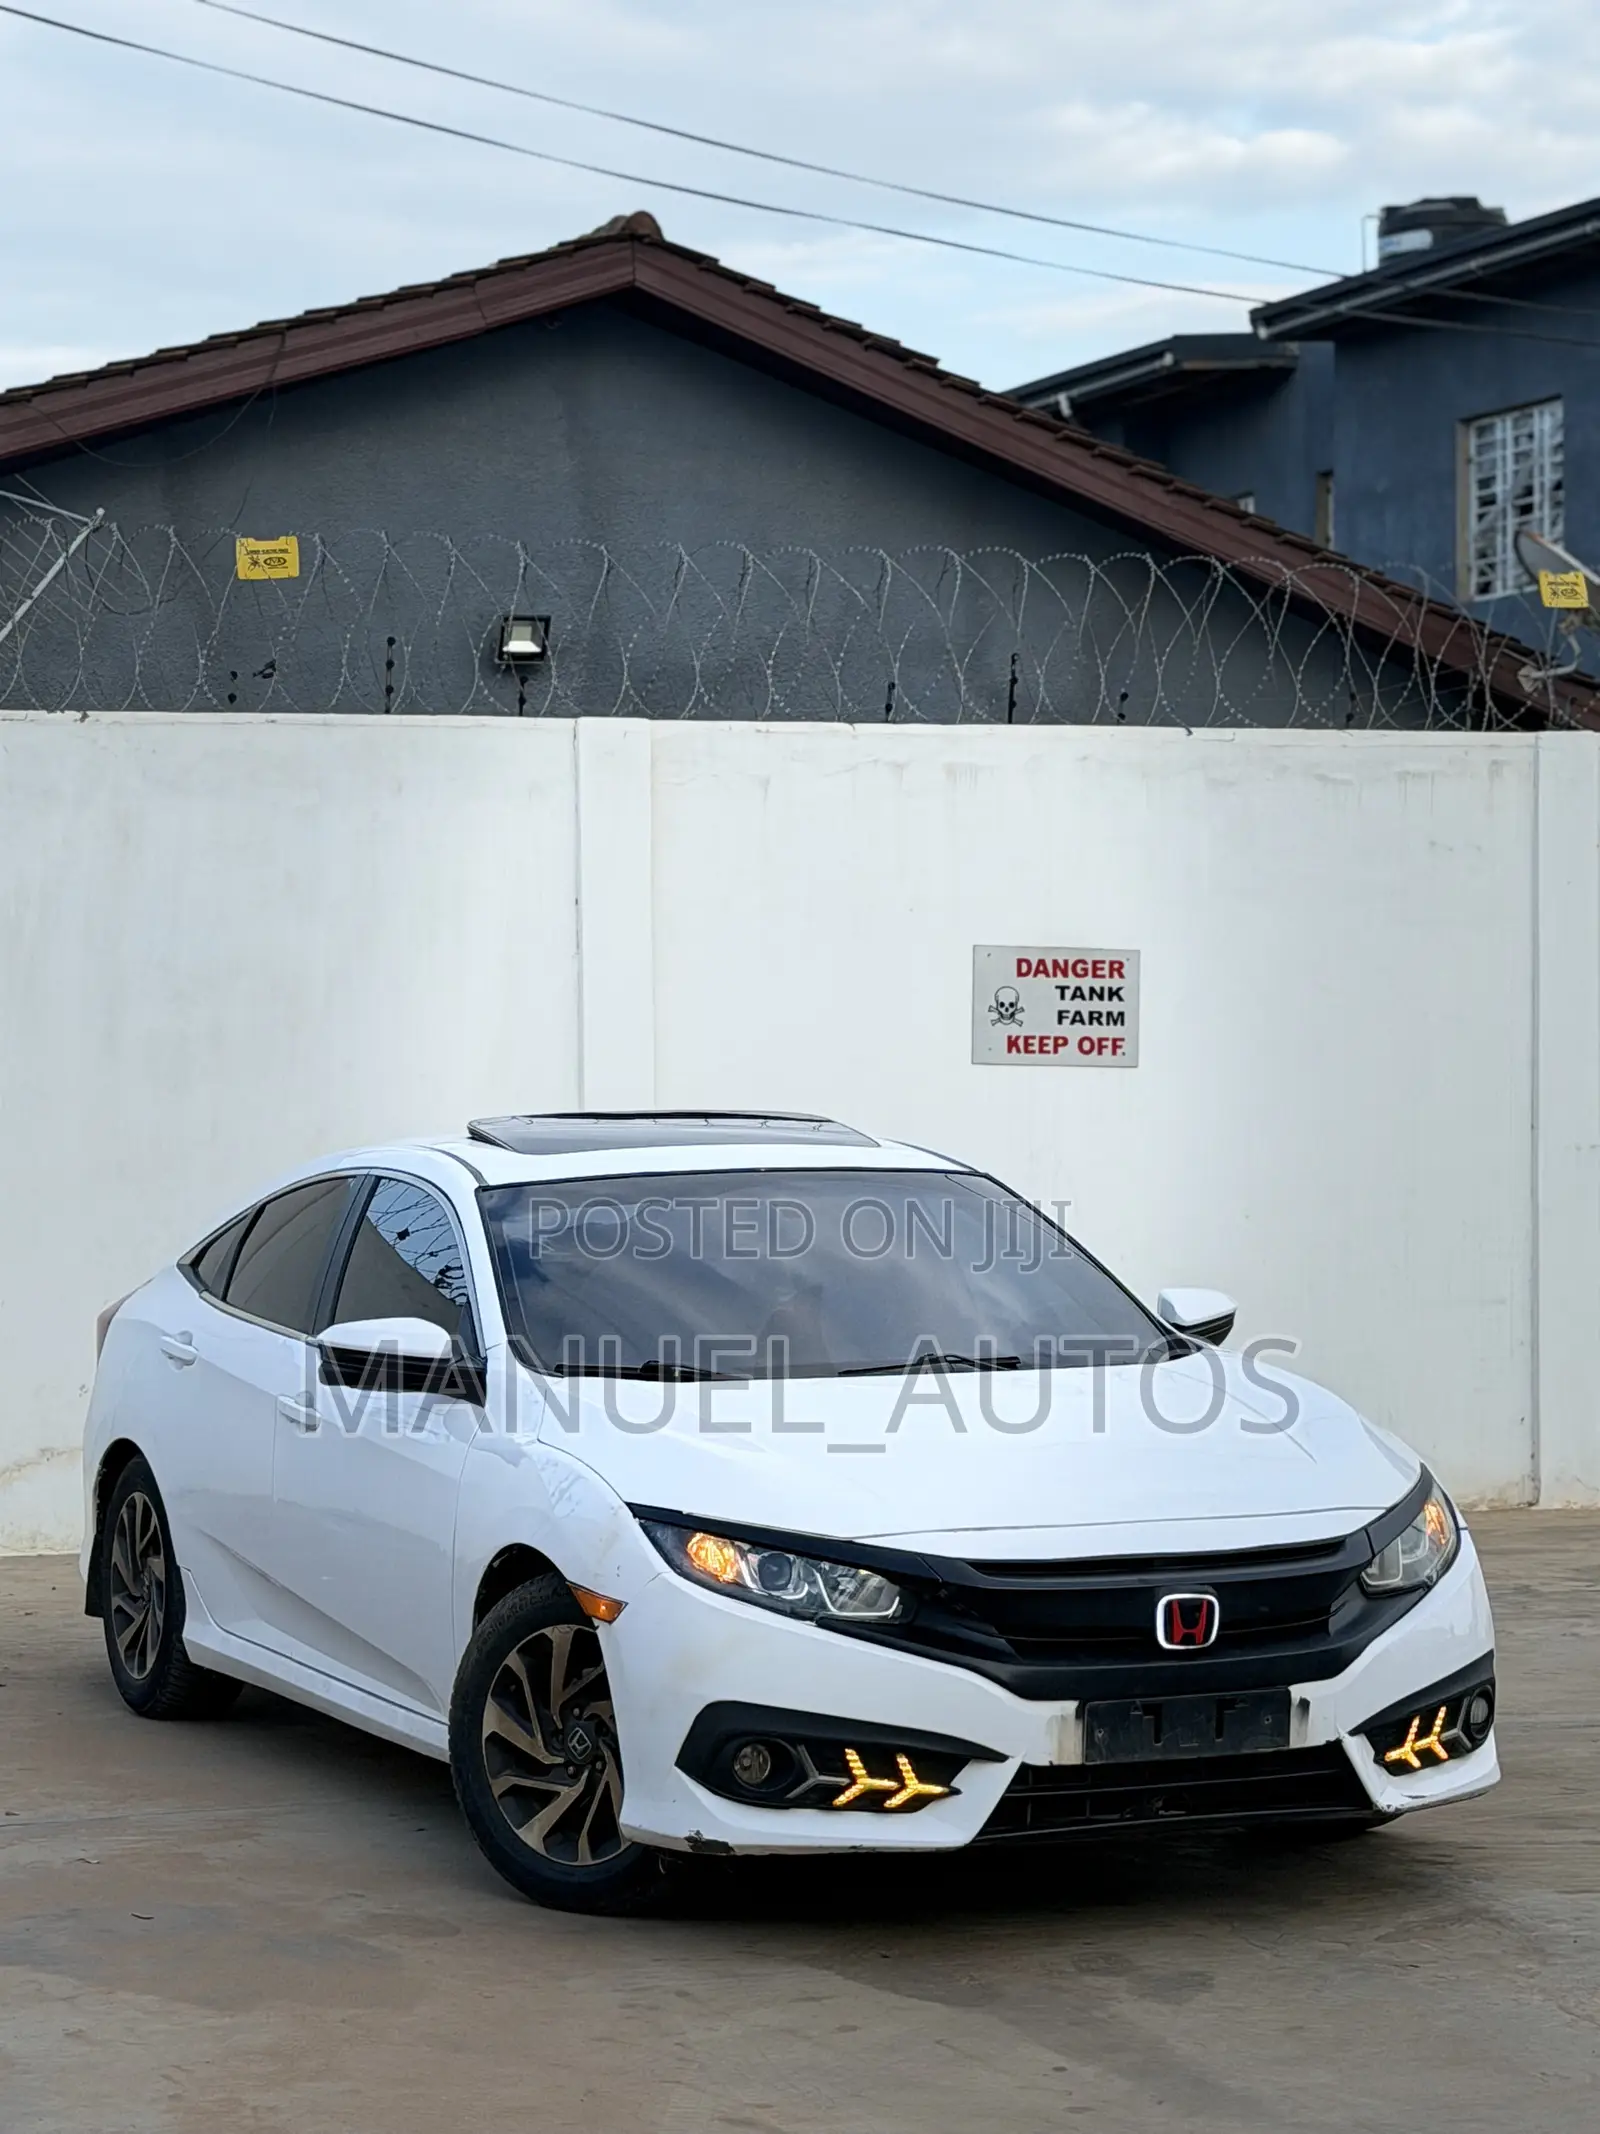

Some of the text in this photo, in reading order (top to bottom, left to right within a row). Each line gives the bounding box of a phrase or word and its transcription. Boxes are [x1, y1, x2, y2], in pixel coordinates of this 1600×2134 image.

[1016, 957, 1125, 979] DANGER
[1054, 985, 1125, 1002] TANK
[1056, 1009, 1125, 1026] FARM
[1006, 1035, 1069, 1055] KEEP
